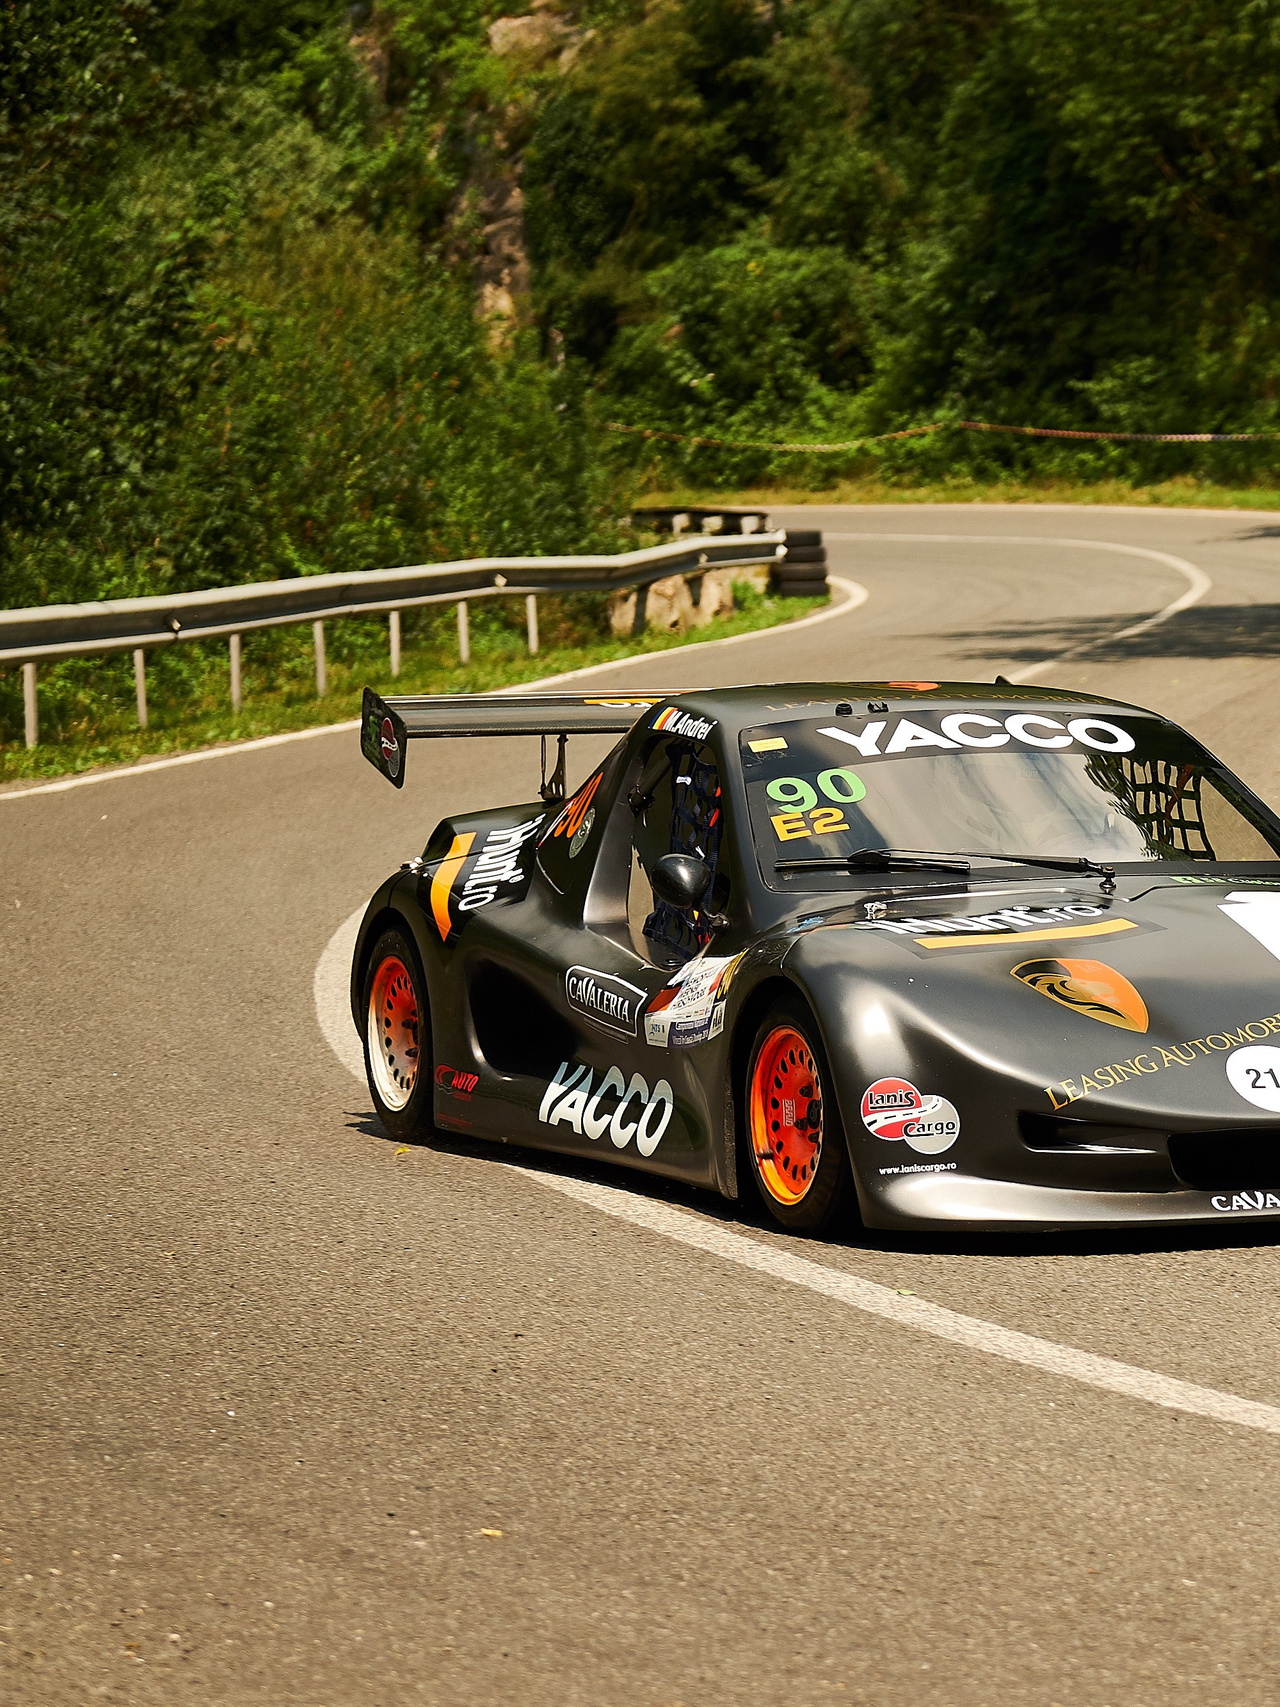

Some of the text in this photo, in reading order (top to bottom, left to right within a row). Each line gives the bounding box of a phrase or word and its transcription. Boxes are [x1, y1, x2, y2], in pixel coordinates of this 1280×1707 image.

[663, 710, 718, 740] M.Andrei
[815, 713, 1136, 757] YACCO
[766, 768, 868, 814] 90
[769, 806, 851, 842] E2
[568, 976, 631, 1022] CAVALERIA
[451, 1069, 479, 1093] AUTO
[868, 1089, 915, 1109] Ianis
[1043, 1053, 1160, 1111] LEASING
[538, 1061, 675, 1157] YACCO
[784, 1099, 794, 1127] BRAID
[902, 1121, 957, 1138] Cargo
